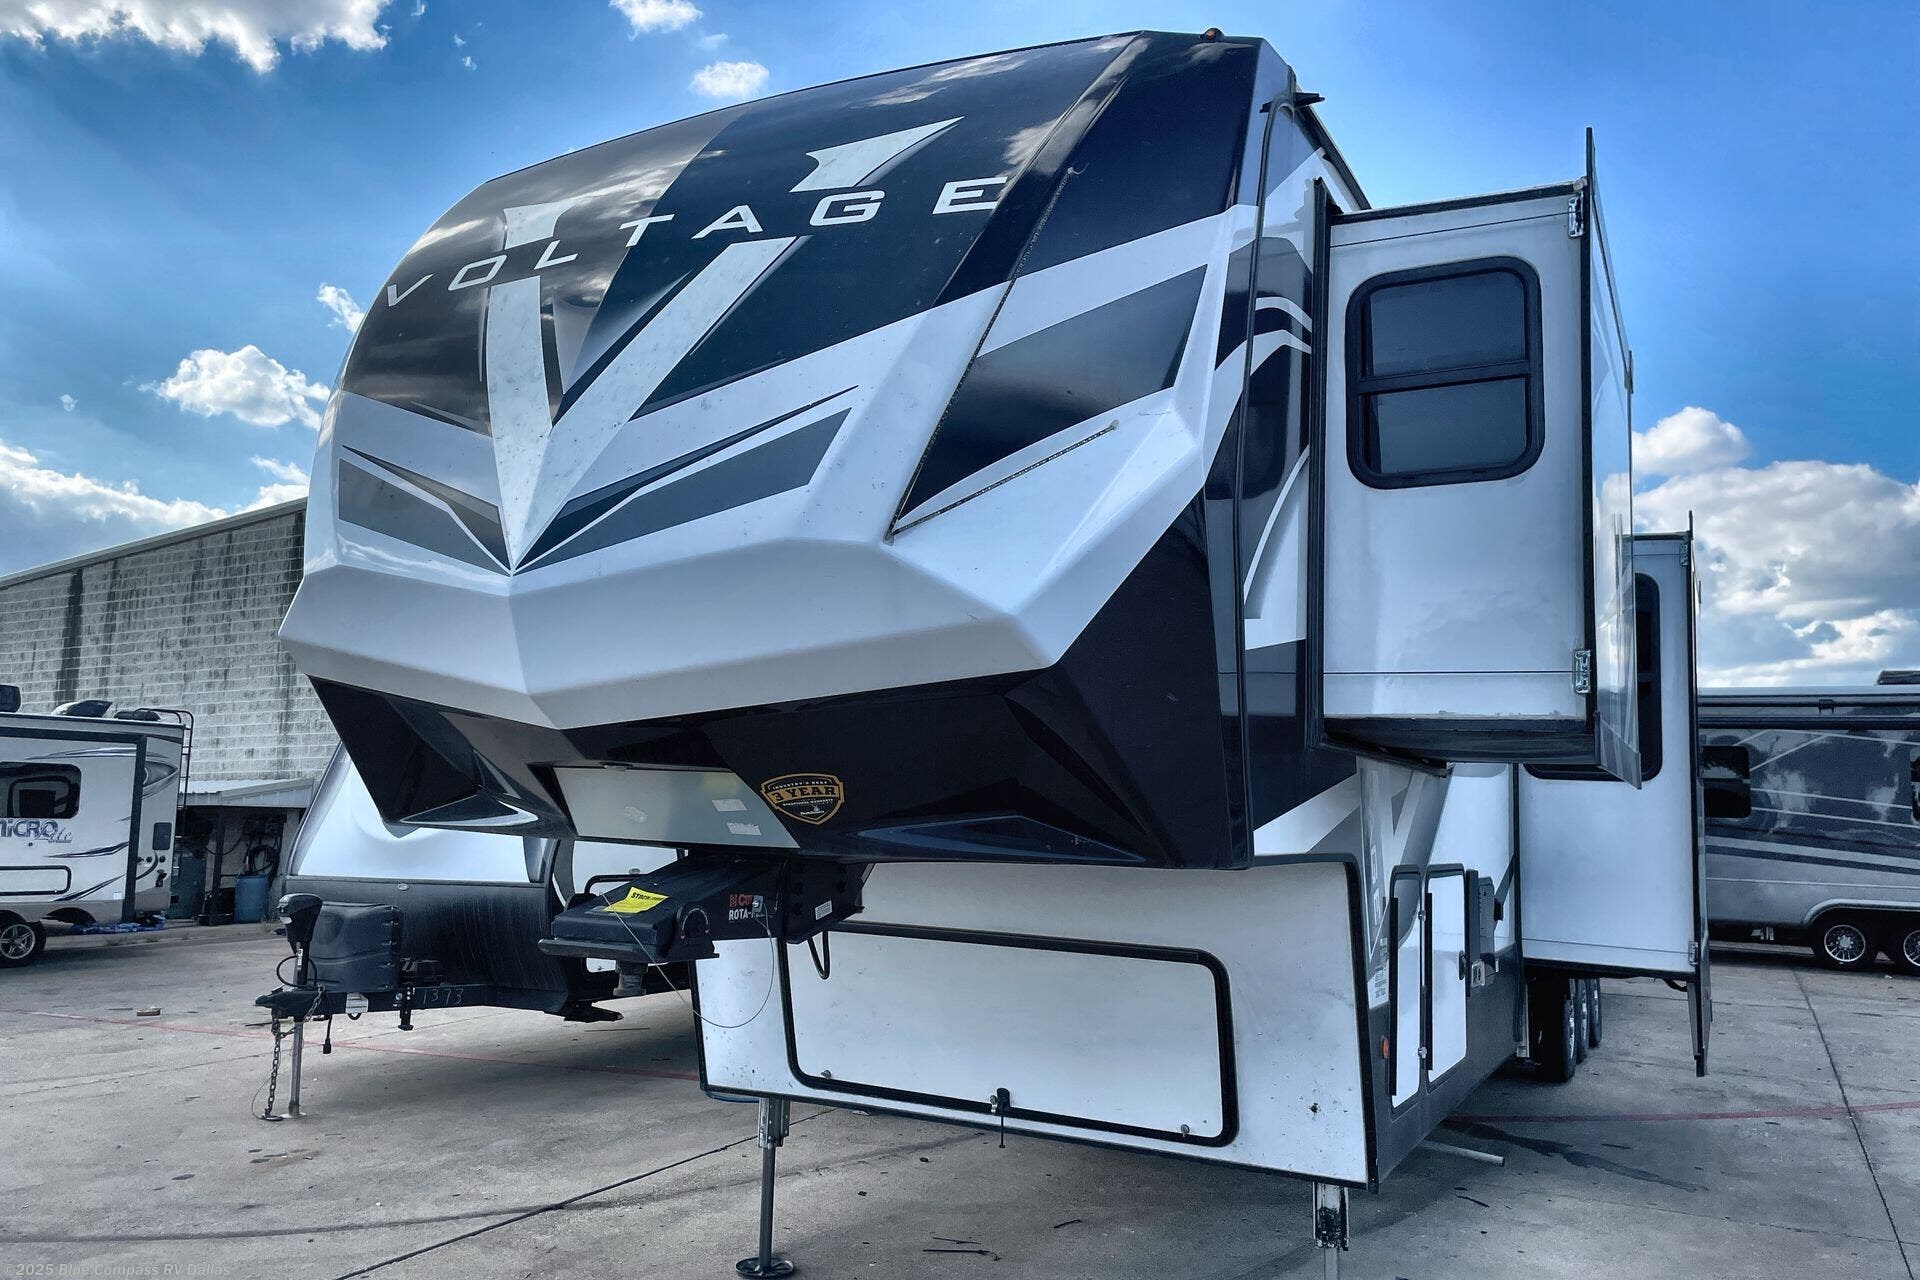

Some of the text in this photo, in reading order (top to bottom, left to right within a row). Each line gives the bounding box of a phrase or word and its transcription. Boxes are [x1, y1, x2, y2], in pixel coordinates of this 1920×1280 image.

[386, 176, 1008, 308] VOLTAGE
[772, 787, 836, 801] 3 YEAR
